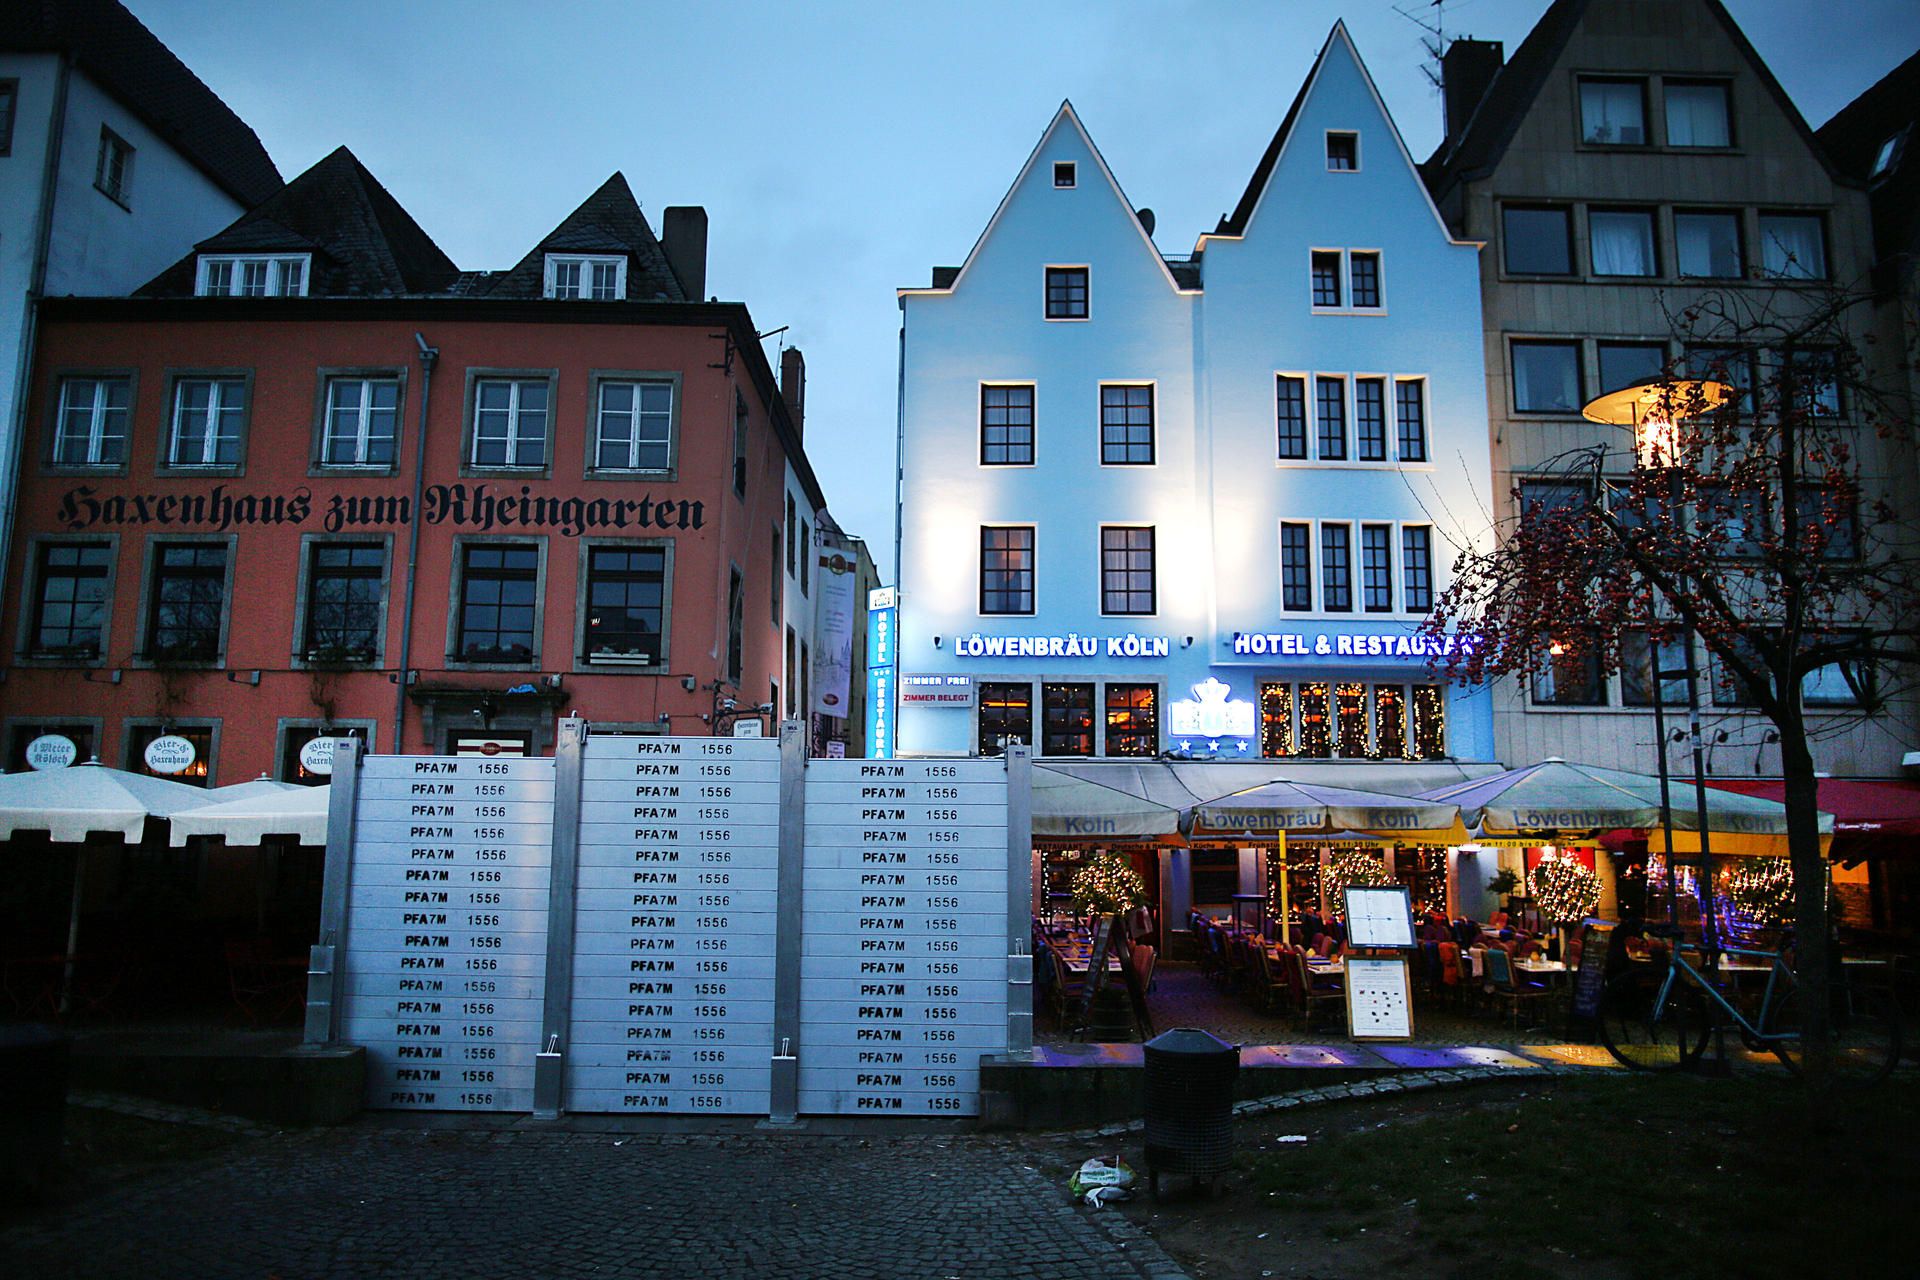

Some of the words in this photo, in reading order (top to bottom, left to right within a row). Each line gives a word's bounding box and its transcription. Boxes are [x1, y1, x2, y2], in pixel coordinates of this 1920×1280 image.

[57, 485, 312, 532] Haxenhaus
[324, 494, 412, 533] zum
[423, 484, 707, 537] Rheingarten
[877, 611, 888, 663] HOTEL
[955, 632, 1098, 657] LÖWENBRÄU
[1107, 632, 1170, 657] KÖLN
[1234, 633, 1310, 655] HOTEL
[1315, 634, 1332, 655] &
[903, 676, 942, 685] ZIMMER
[946, 676, 970, 685] FREI
[903, 694, 936, 702] ZIMMER
[937, 694, 969, 702] BELEGT
[639, 744, 680, 753] PFA7M
[701, 745, 732, 754] 1556
[416, 763, 457, 773] PFA7M
[478, 764, 508, 774] 1556
[637, 765, 678, 775] PFA7M
[700, 766, 730, 775] 1556
[862, 767, 903, 776] PFA7M
[925, 767, 956, 776] 1556
[412, 784, 453, 794] PFA7M
[474, 786, 504, 795] 1556
[637, 787, 678, 796] PFA7M
[700, 787, 731, 797] 1556
[863, 788, 905, 798] PFA7M
[926, 788, 957, 798] 1556
[412, 806, 453, 816] PFA7M
[474, 807, 505, 816] 1556
[634, 808, 676, 818] PFA7M
[698, 809, 728, 818] 1556
[863, 810, 904, 819] PFA7M
[926, 810, 957, 819] 1556
[1202, 809, 1321, 829] Löwenbräu
[1065, 816, 1117, 834] Köln
[411, 827, 452, 837] PFA7M
[473, 828, 504, 838] 1556
[636, 830, 677, 839] PFA7M
[699, 830, 730, 840] 1556
[864, 832, 906, 841] PFA7M
[928, 832, 958, 841] 1556
[412, 849, 453, 859] PFA7M
[475, 850, 505, 860] 1556
[636, 851, 678, 861] PFA7M
[700, 852, 730, 862] 1556
[863, 853, 905, 863] PFA7M
[927, 854, 958, 863] 1556
[406, 870, 448, 880] PFA7M
[470, 872, 500, 881] 1556
[634, 873, 676, 883] PFA7M
[698, 874, 729, 883] 1556
[862, 875, 904, 884] PFA7M
[925, 875, 957, 885] 1556
[405, 892, 447, 902] PFA7M
[469, 894, 500, 903] 1556
[634, 895, 677, 905] PFA7M
[698, 896, 729, 905] 1556
[862, 897, 905, 906] PFA7M
[926, 897, 957, 907] 1556
[404, 914, 446, 924] PFA7M
[467, 915, 498, 925] 1556
[632, 917, 675, 927] PFA7M
[696, 918, 727, 927] 1556
[861, 919, 903, 928] PFA7M
[925, 920, 956, 929] 1556
[405, 936, 448, 947] PFA7M
[470, 937, 501, 948] 1556
[631, 939, 674, 949] PFA7M
[695, 940, 726, 950] 1556
[862, 941, 904, 950] PFA7M
[926, 941, 957, 951] 1556
[401, 958, 444, 968] PFA7M
[465, 959, 496, 969] 1556
[631, 961, 674, 971] PFA7M
[696, 962, 727, 972] 1556
[861, 963, 904, 973] PFA7M
[926, 964, 958, 973] 1556
[400, 980, 442, 990] PFA7M
[463, 982, 495, 992] 1556
[630, 983, 672, 993] PFA7M
[694, 984, 725, 994] 1556
[861, 985, 904, 995] PFA7M
[926, 986, 958, 996] 1556
[398, 1002, 440, 1013] PFA7M
[462, 1004, 494, 1014] 1556
[629, 1005, 672, 1016] PFA7M
[694, 1006, 726, 1016] 1556
[859, 1007, 902, 1018] PFA7M
[924, 1008, 956, 1018] 1556
[397, 1025, 440, 1035] PFA7M
[462, 1026, 493, 1036] 1556
[628, 1028, 671, 1038] PFA7M
[693, 1029, 724, 1039] 1556
[858, 1030, 901, 1040] PFA7M
[922, 1031, 954, 1041] 1556
[398, 1047, 442, 1058] PFA7M
[463, 1048, 495, 1059] 1556
[693, 1051, 724, 1061] 1556
[859, 1053, 902, 1063] PFA7M
[924, 1053, 956, 1063] 1556
[395, 1070, 440, 1081] PFA7M
[461, 1071, 494, 1082] 1556
[627, 1073, 669, 1083] PFA7M
[692, 1074, 723, 1084] 1556
[858, 1074, 901, 1085] PFA7M
[923, 1076, 955, 1086] 1556
[390, 1093, 435, 1104] PFA7M
[460, 1094, 492, 1104] 1556
[624, 1096, 668, 1106] PFA7M
[689, 1097, 721, 1107] 1556
[858, 1098, 902, 1108] PFA7M
[927, 1098, 960, 1109] 1556
